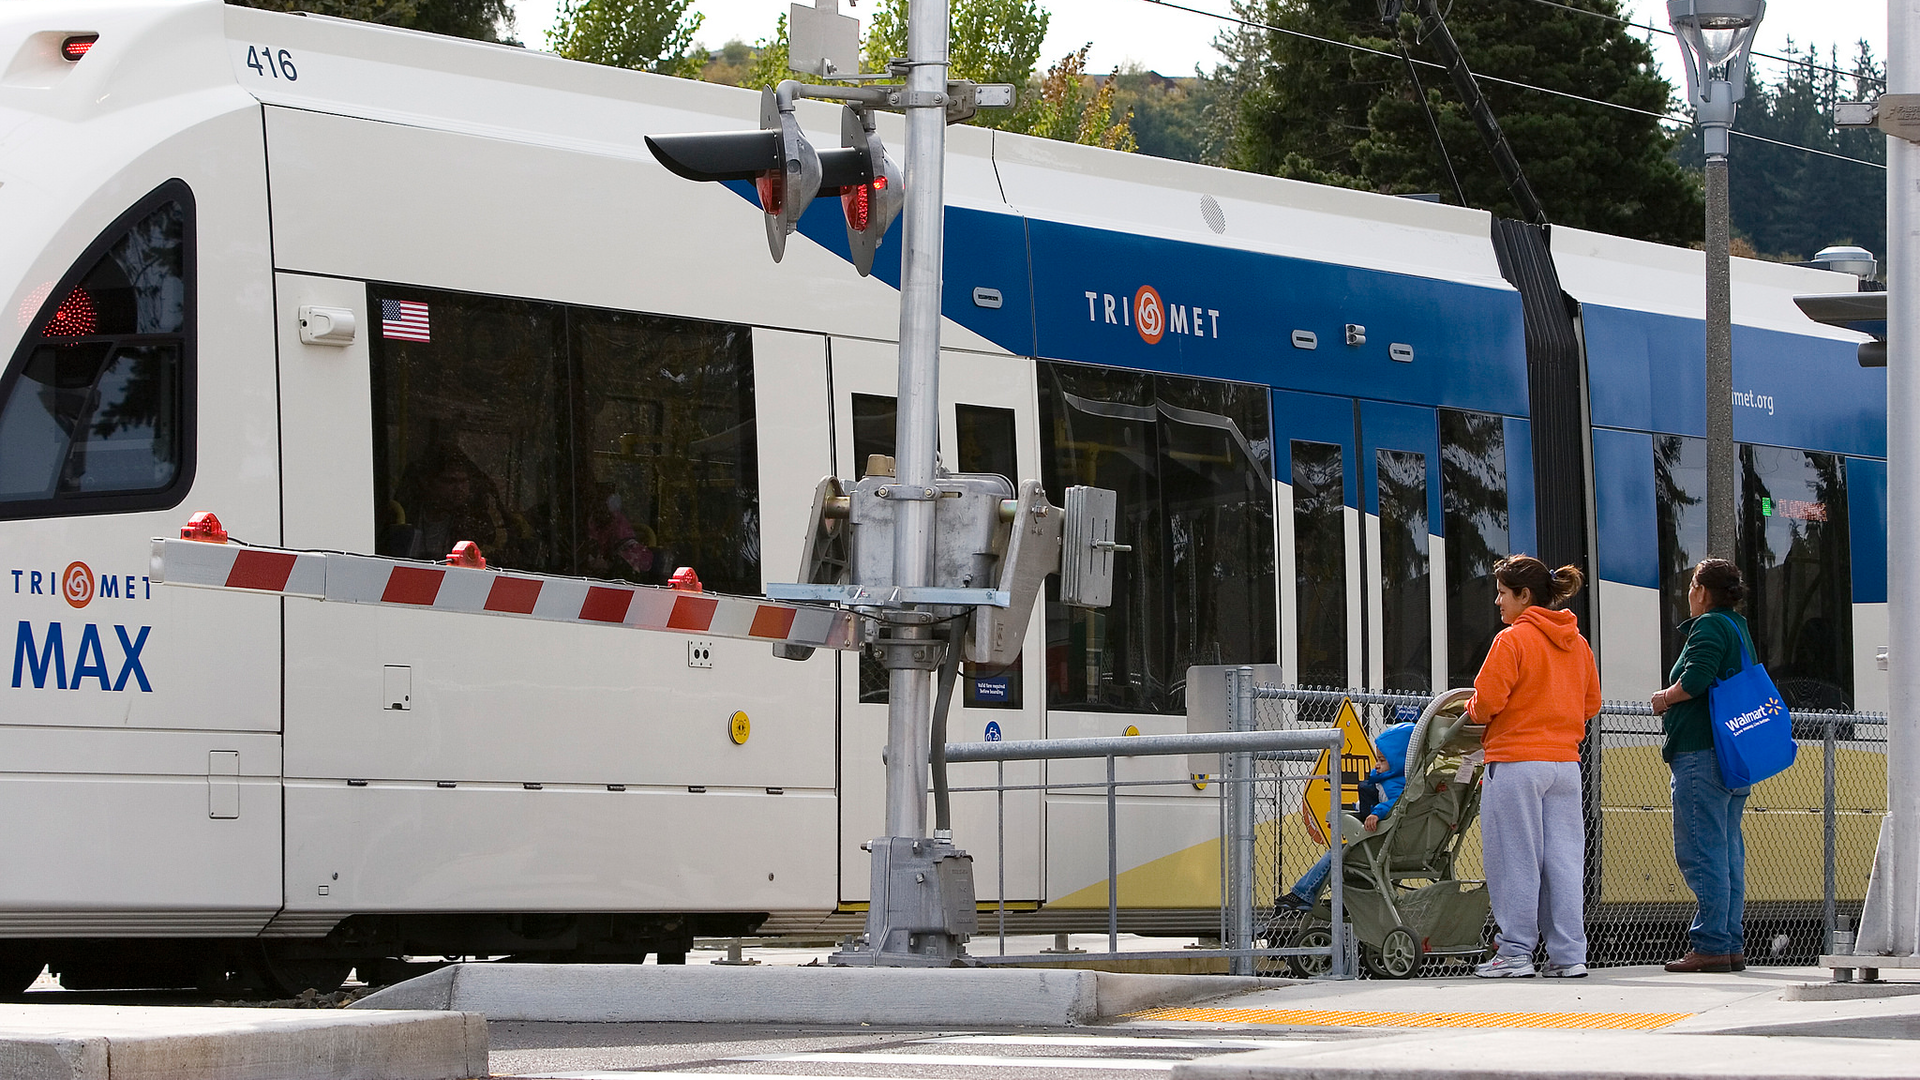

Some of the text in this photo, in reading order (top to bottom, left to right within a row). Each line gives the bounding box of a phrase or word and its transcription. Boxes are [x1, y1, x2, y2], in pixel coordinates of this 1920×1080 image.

[246, 44, 298, 82] 416
[1085, 290, 1220, 339] TRI MET
[11, 569, 151, 600] TRI MET
[11, 620, 154, 693] MAX
[1724, 705, 1768, 732] Walmart
